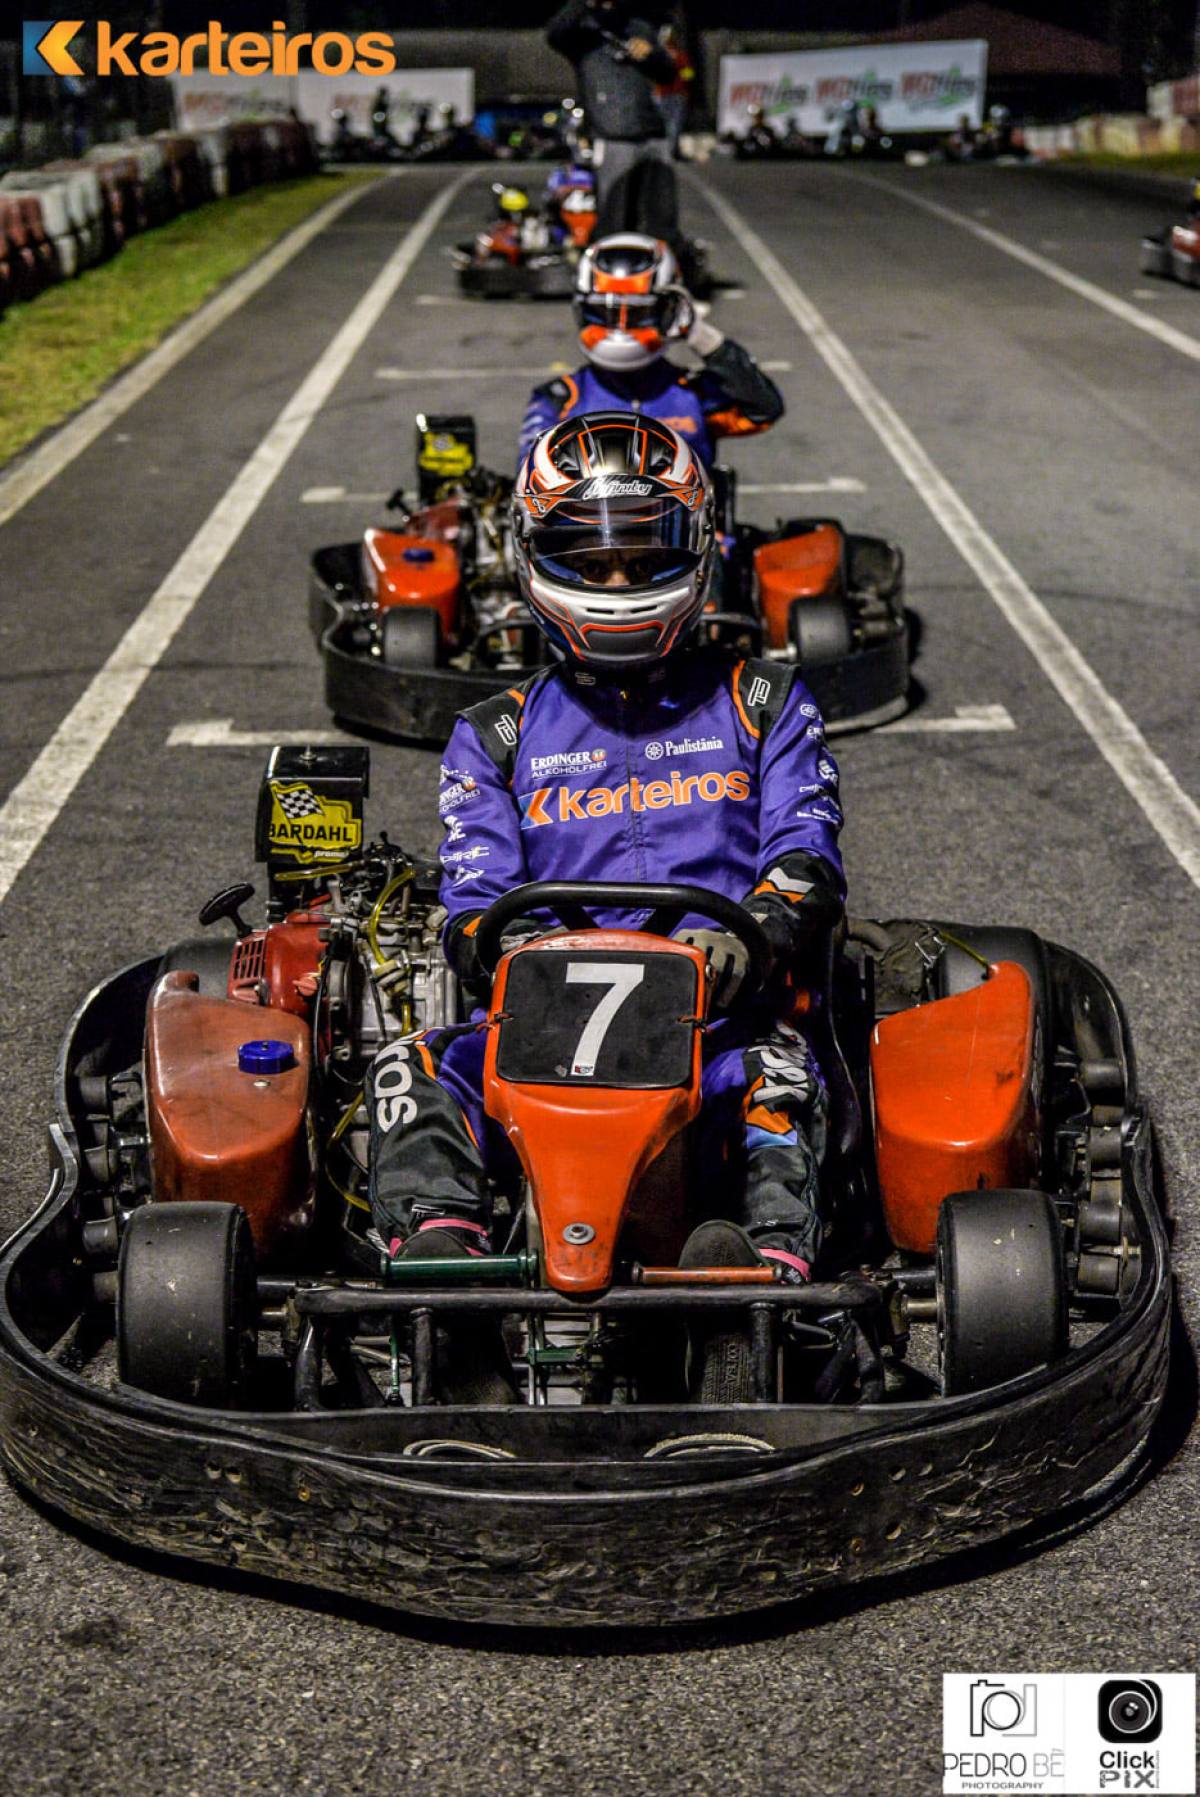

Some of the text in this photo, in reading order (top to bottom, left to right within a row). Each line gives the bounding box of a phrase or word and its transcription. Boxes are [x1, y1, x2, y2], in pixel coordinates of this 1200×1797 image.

[665, 736, 724, 757] Paulistânia
[531, 751, 592, 771] ERDINGER
[532, 760, 608, 779] ALKOHOLFREI
[559, 770, 750, 823] karteiros
[268, 822, 354, 843] BARDAHL
[565, 962, 645, 1076] 7
